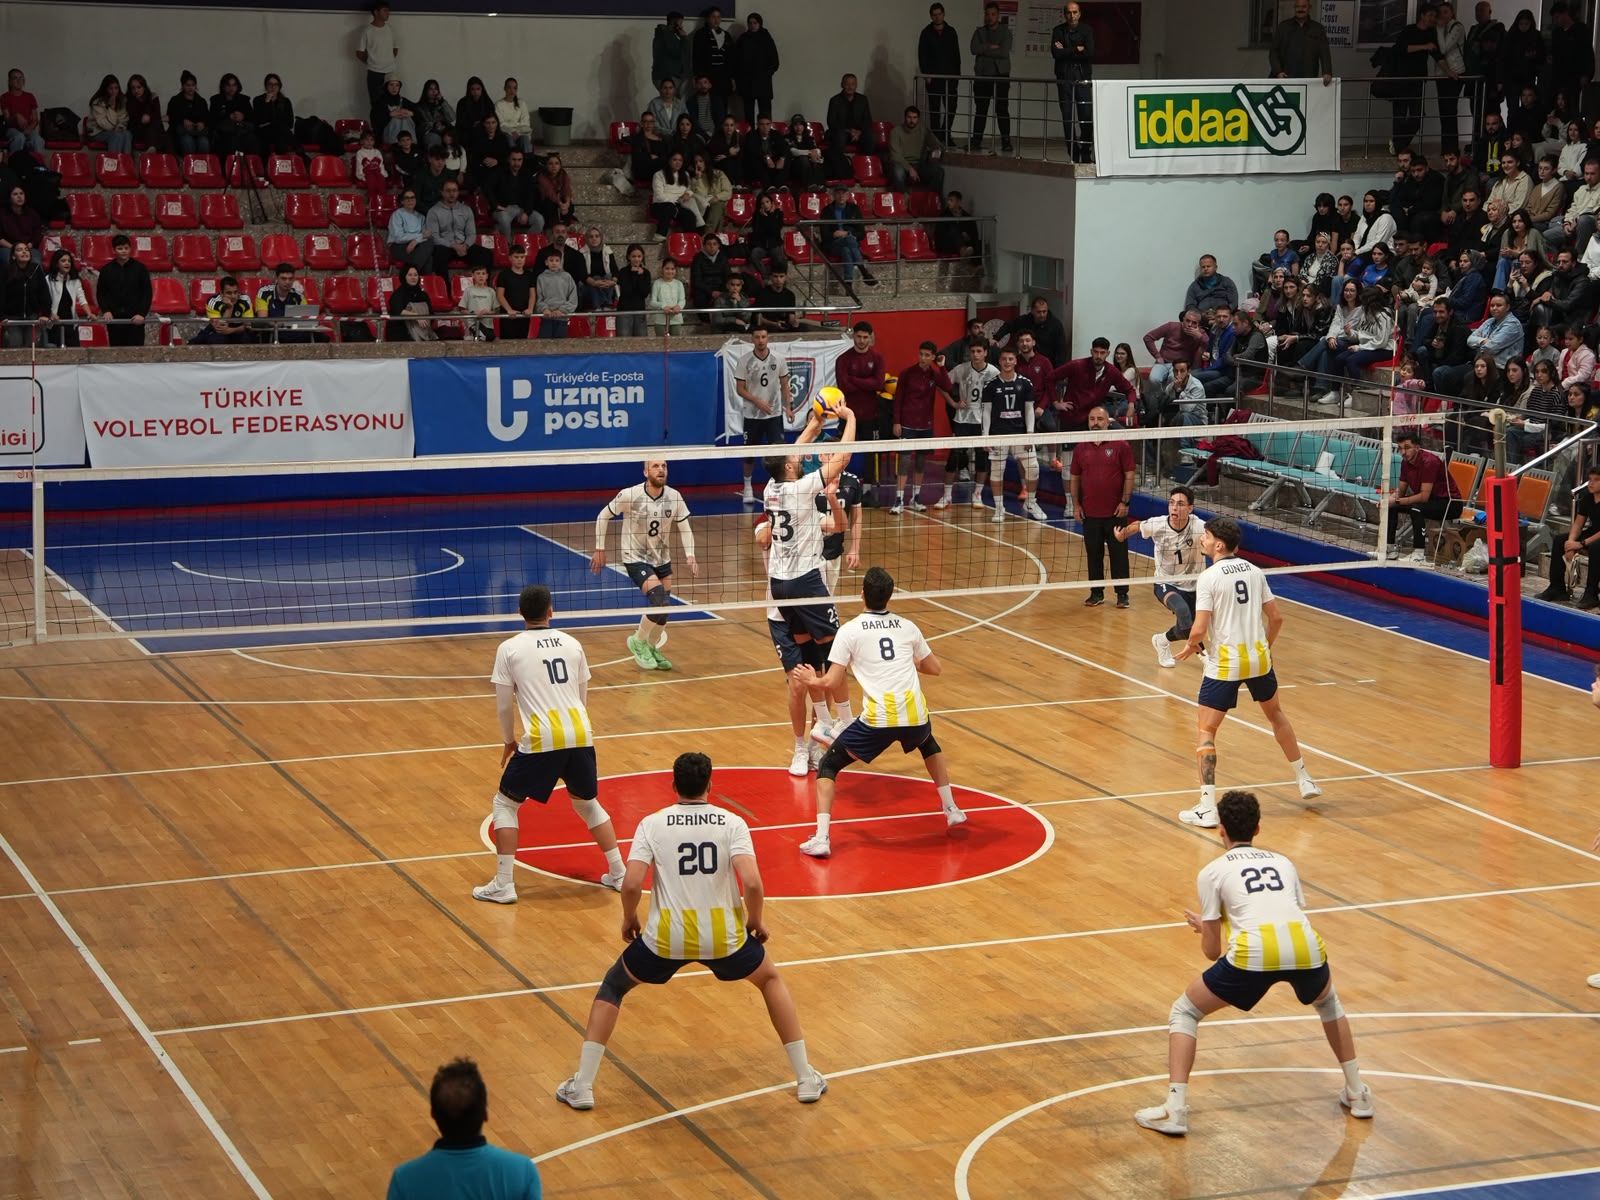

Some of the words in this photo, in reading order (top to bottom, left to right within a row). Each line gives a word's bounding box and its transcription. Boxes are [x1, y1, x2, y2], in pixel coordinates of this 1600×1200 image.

[1138, 99, 1249, 144] iddaa
[544, 372, 600, 385] Türkiye'de
[602, 371, 644, 384] E-posta
[760, 372, 769, 387] 6
[200, 386, 303, 409] TÜRKİYE
[544, 385, 645, 407] uzman
[971, 387, 980, 403] 9
[1004, 393, 1017, 410] 17
[93, 417, 223, 438] VOLEYBOL
[232, 413, 404, 434] FEDERASYONU
[544, 407, 629, 435] posta
[0, 429, 27, 446] İGİ
[648, 520, 660, 537] 8
[1174, 549, 1183, 565] 1
[1234, 580, 1250, 605] 9
[861, 618, 902, 631] BARLAK
[536, 636, 563, 649] ATİK
[879, 637, 896, 661] 8
[542, 657, 569, 685] 10
[666, 812, 726, 827] DERİNCE
[677, 841, 718, 876] 20
[1240, 866, 1285, 894] 23
